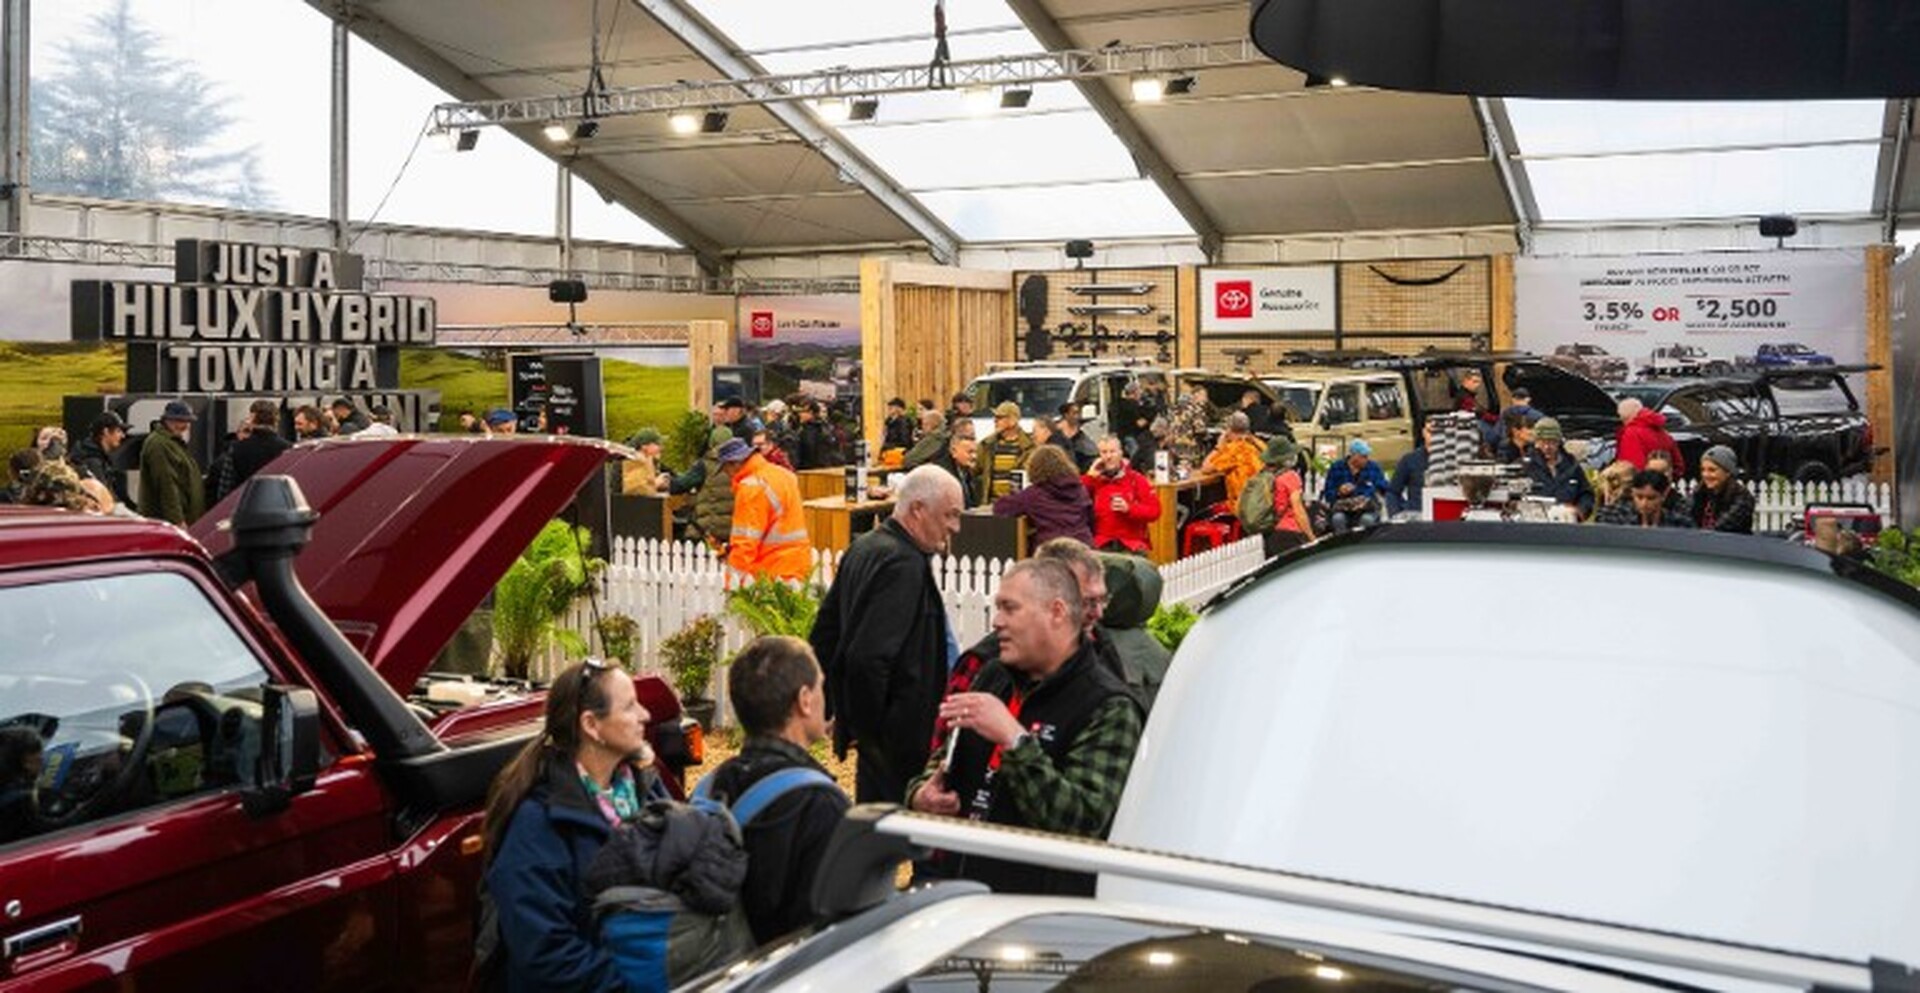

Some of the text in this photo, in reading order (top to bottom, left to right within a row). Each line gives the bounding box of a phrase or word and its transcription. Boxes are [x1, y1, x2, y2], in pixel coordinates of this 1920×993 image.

[214, 243, 336, 289] JUST A
[112, 282, 435, 342] HILUX HYBRID
[1583, 298, 1777, 321] 3.5% OR $2,500
[168, 346, 376, 392] TOWING A
